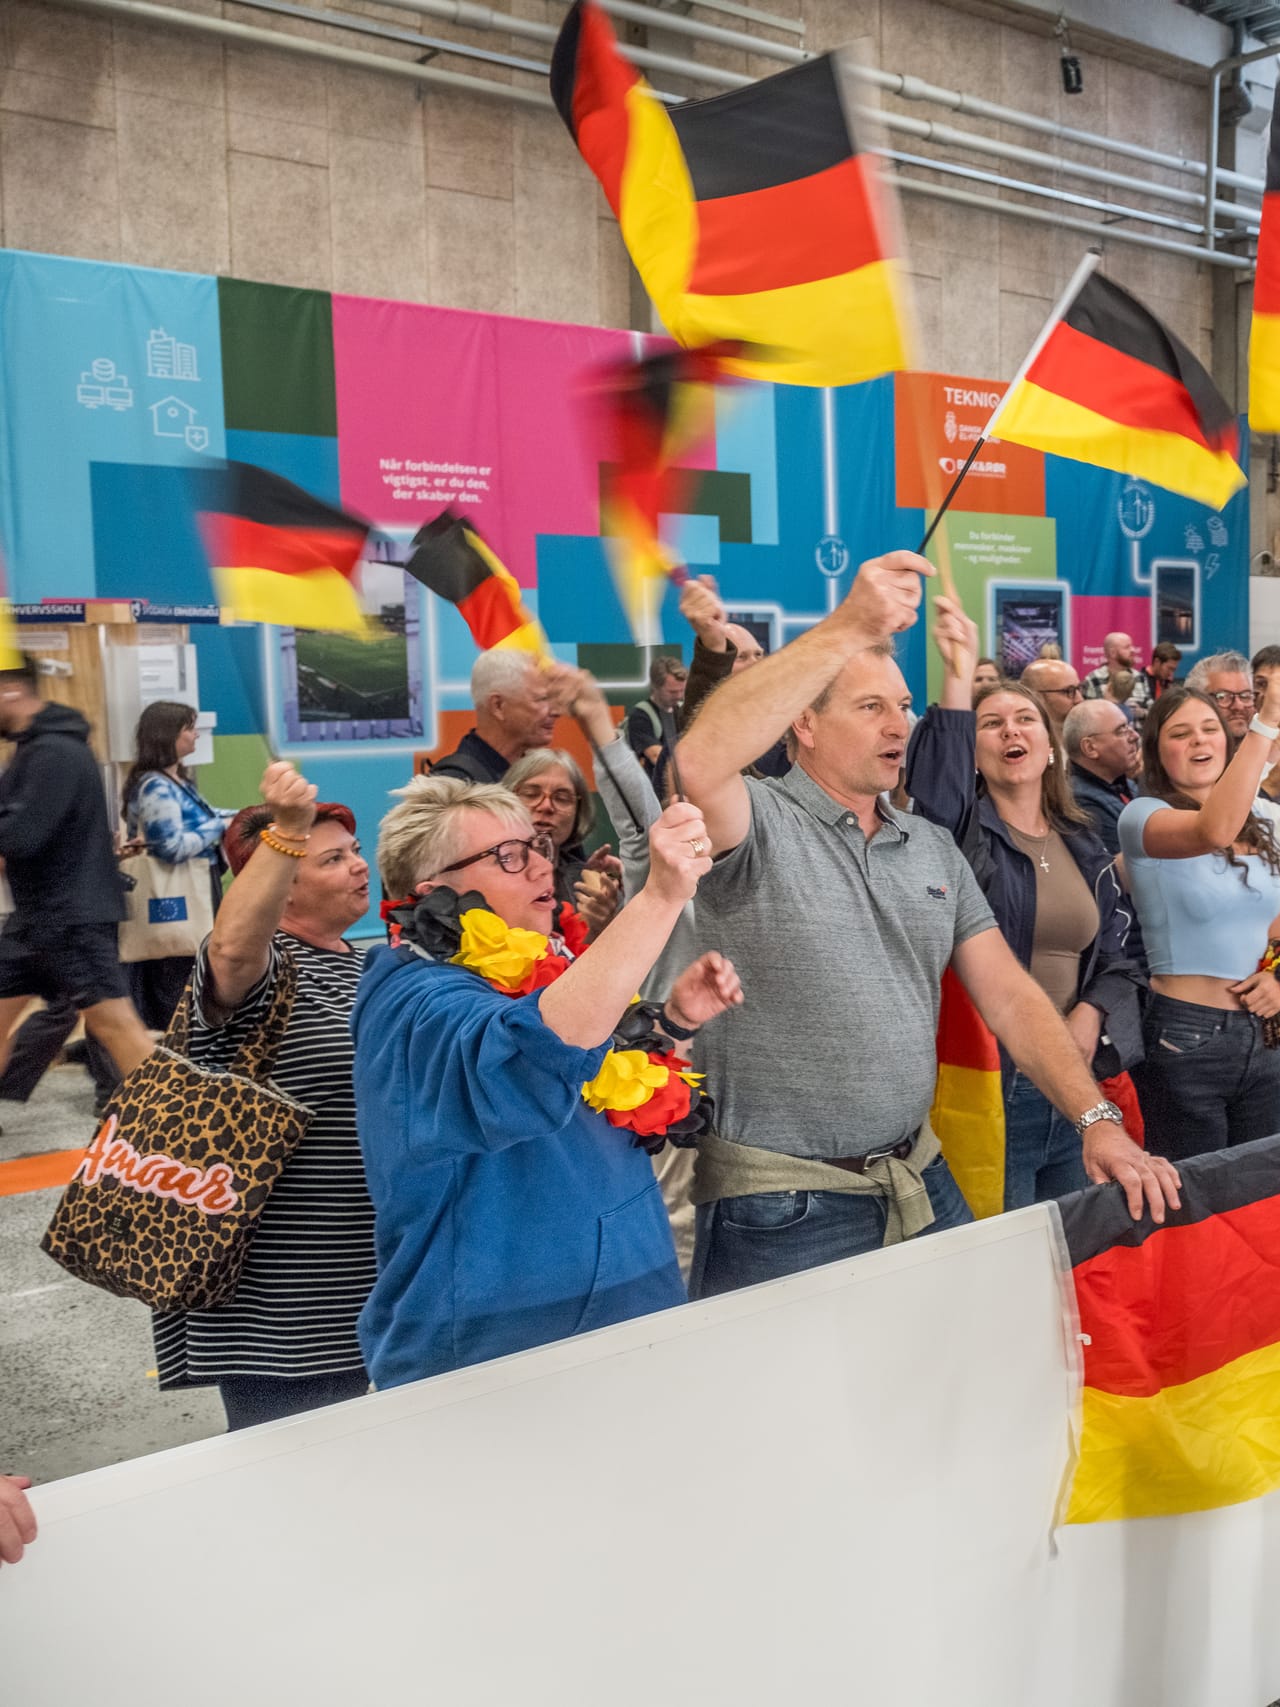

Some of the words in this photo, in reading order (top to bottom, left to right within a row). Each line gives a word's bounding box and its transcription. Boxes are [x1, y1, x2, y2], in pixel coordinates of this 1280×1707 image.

[943, 386, 1001, 410] TEKNIQ
[380, 458, 402, 471] Når
[405, 459, 478, 475] forbindelsen
[479, 466, 492, 476] er
[382, 474, 432, 488] vigtigst,
[434, 478, 447, 487] er
[449, 477, 465, 488] du
[466, 478, 490, 491] den,
[393, 488, 414, 500] der
[416, 490, 456, 502] skaber
[459, 491, 482, 503] den.
